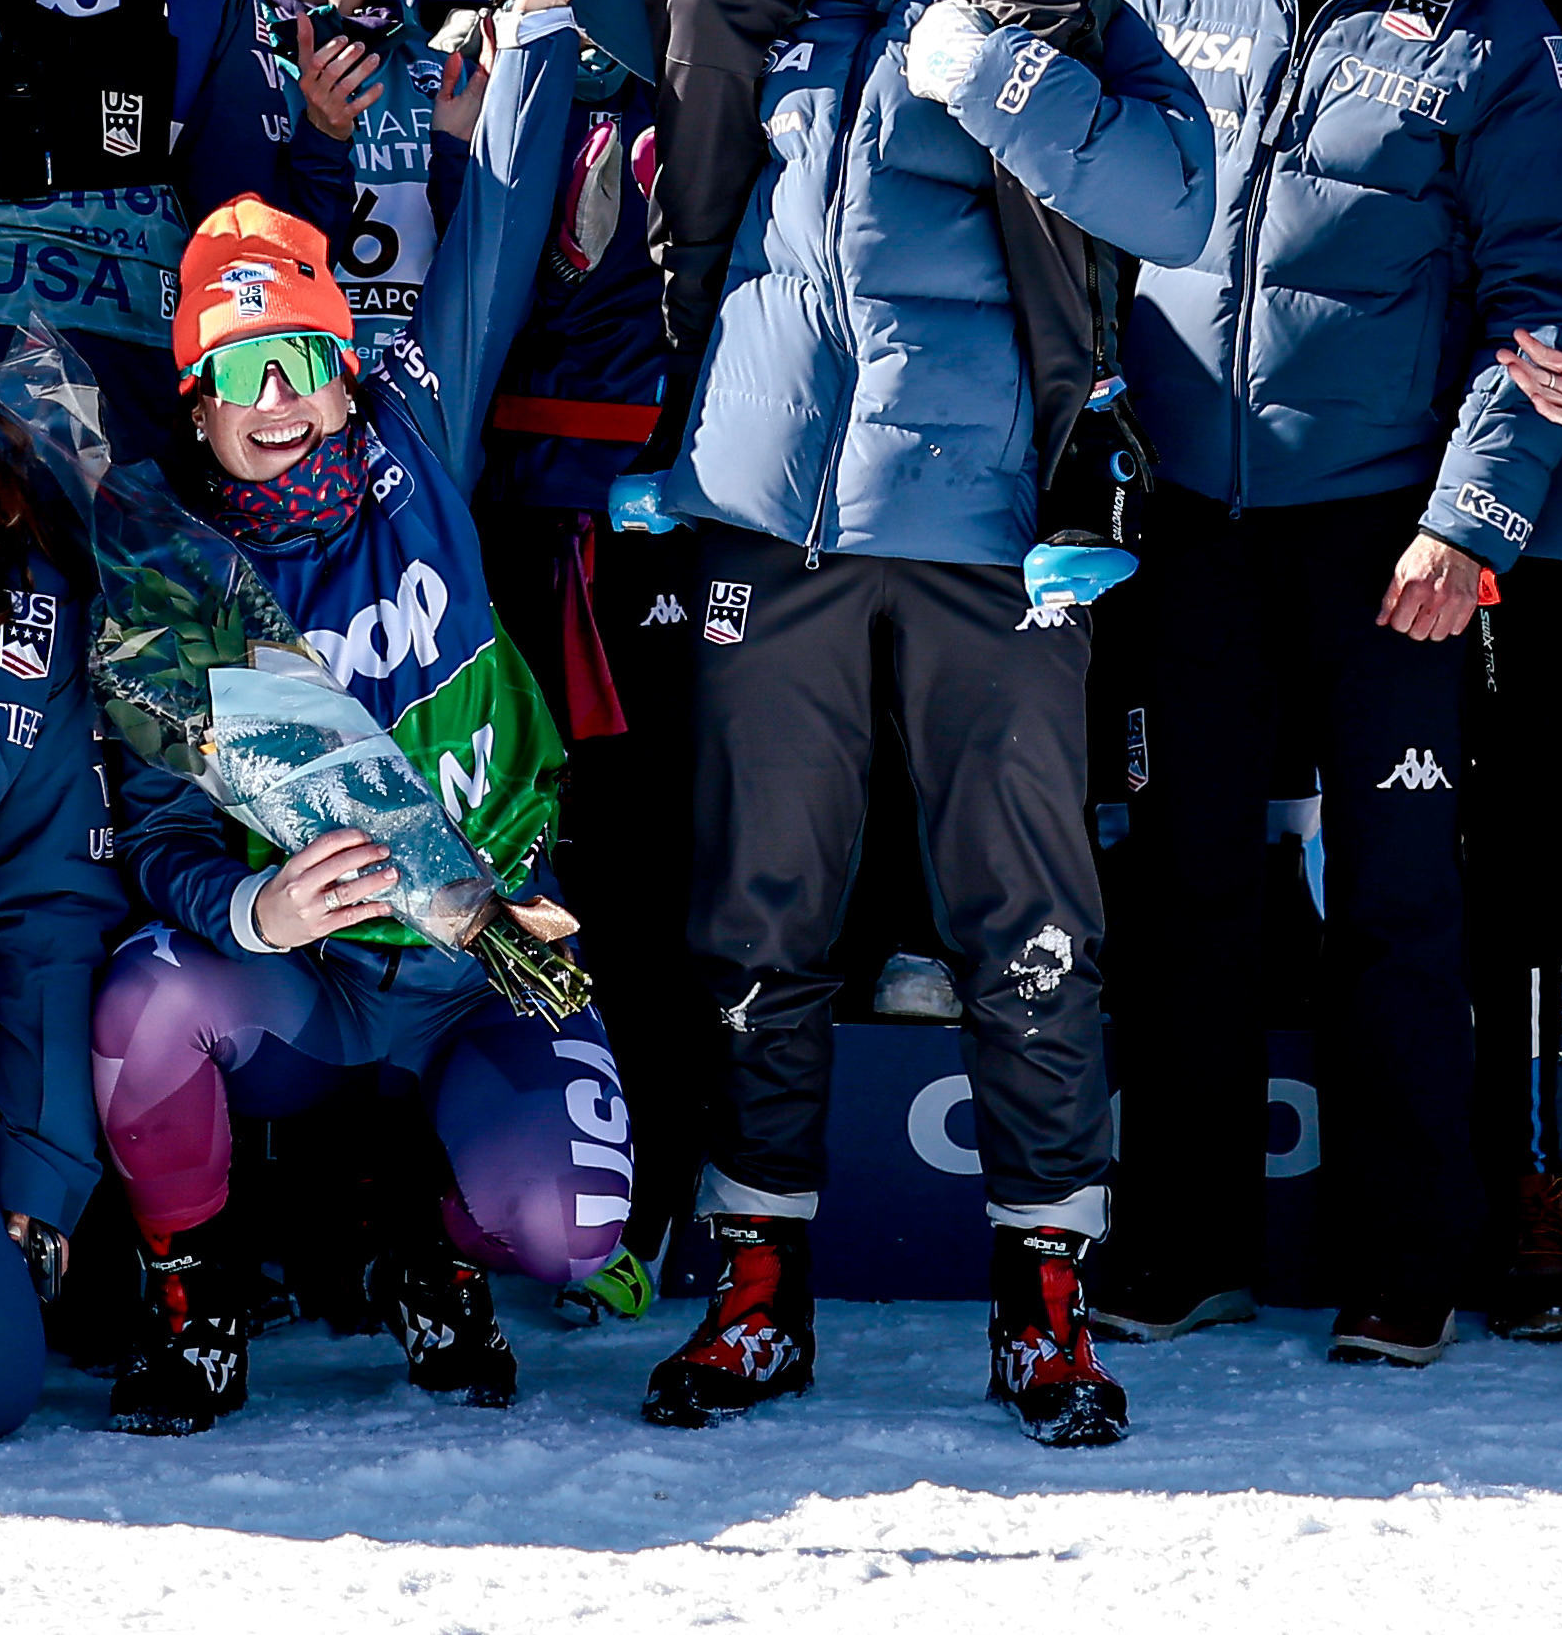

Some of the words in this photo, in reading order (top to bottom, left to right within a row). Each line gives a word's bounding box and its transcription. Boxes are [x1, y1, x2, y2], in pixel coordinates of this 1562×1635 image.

[104, 90, 142, 113] US
[1331, 56, 1452, 126] STIFEL
[338, 187, 400, 279] 6
[239, 285, 265, 299] US
[1111, 486, 1127, 543] SALOMON
[1456, 484, 1531, 551] Kapp
[710, 581, 751, 605] US
[719, 1226, 758, 1241] alpina
[1023, 1237, 1068, 1254] alpina
